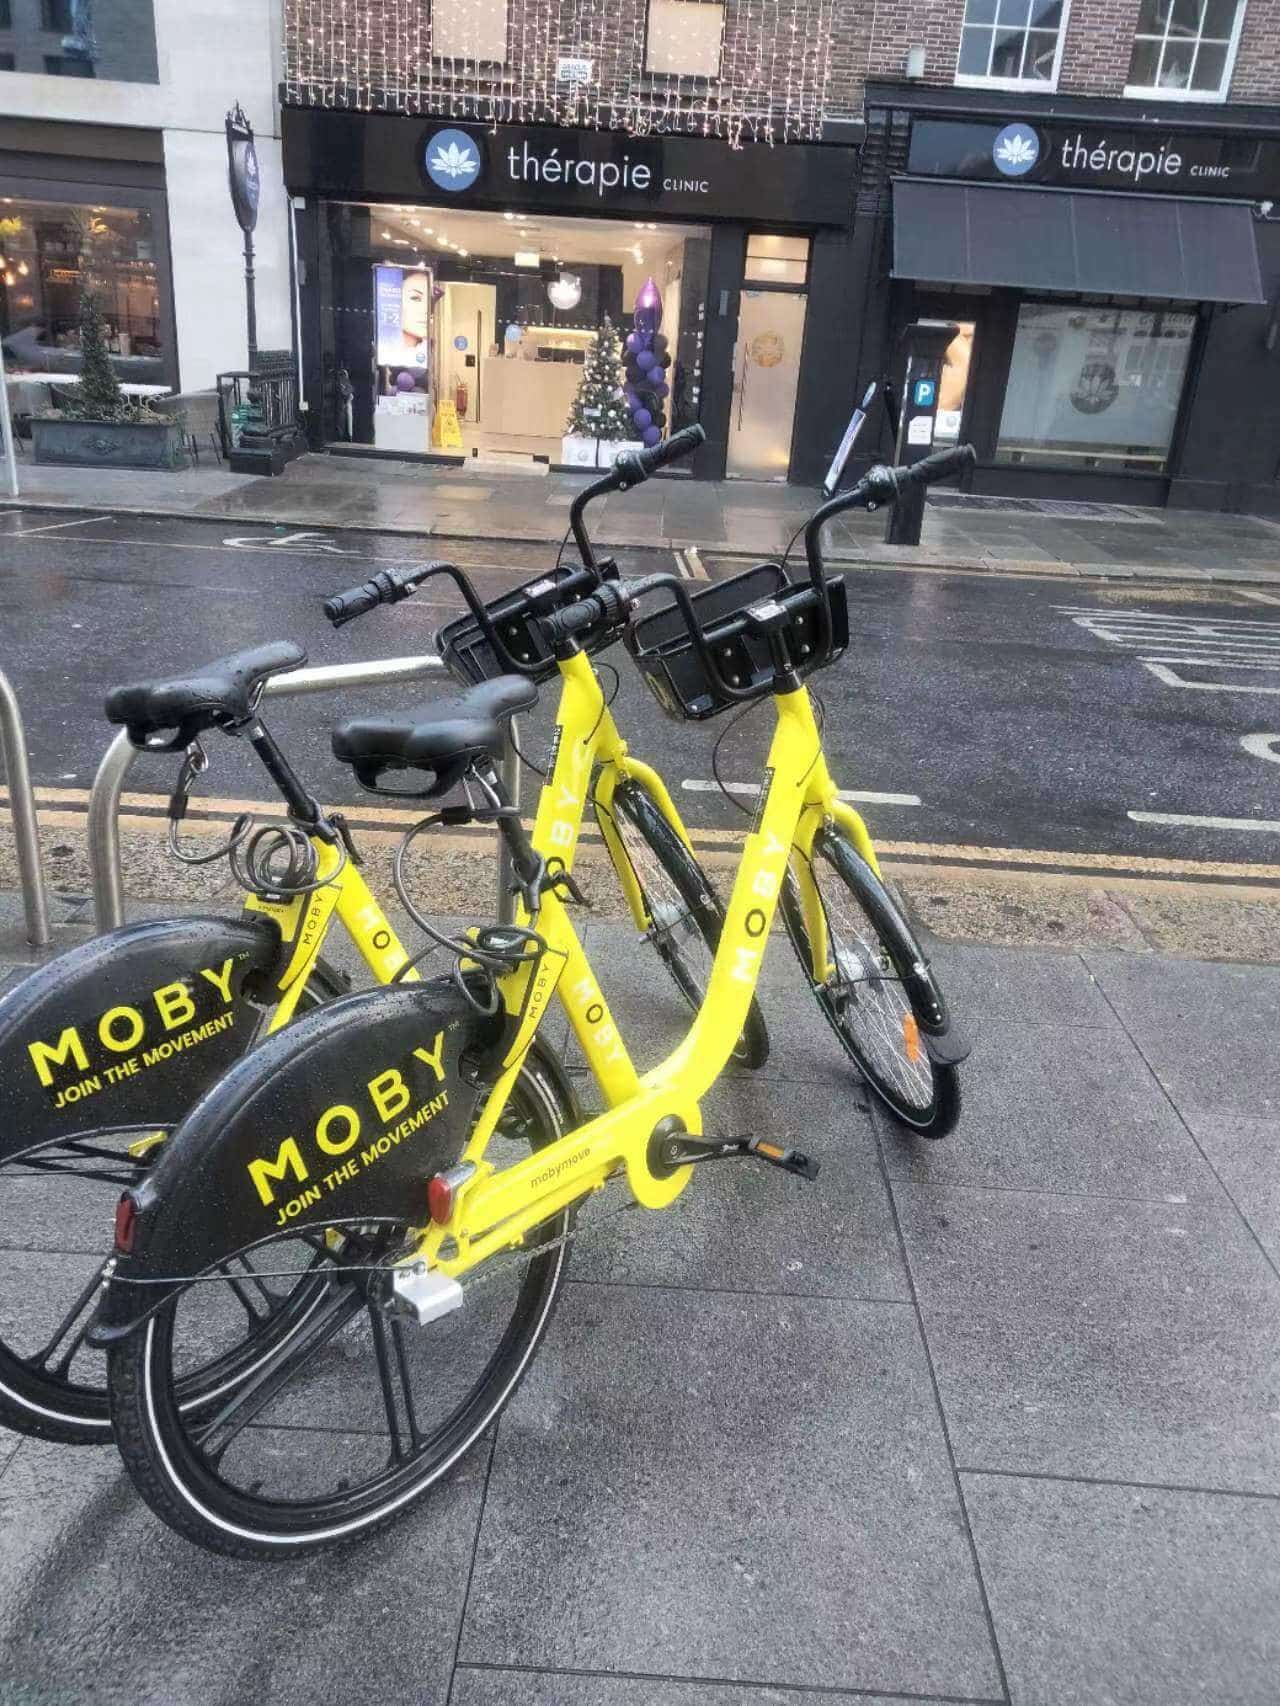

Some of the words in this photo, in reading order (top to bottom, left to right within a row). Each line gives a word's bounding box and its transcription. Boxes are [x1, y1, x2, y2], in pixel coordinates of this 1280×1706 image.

[507, 141, 651, 196] thérapie
[662, 178, 709, 193] CLINIC
[1062, 134, 1182, 181] thérapie
[1190, 165, 1231, 178] CLINIC
[917, 383, 931, 402] P
[303, 893, 325, 945] MOBY
[731, 831, 785, 984] MOBY
[28, 958, 234, 1088] MOBY
[528, 963, 550, 1019] MOBY
[573, 978, 625, 1063] MOBY
[55, 1075, 102, 1109] JOIN
[103, 1058, 141, 1085] THE
[142, 1011, 235, 1067] MOVEMENT
[247, 1030, 445, 1206] MOBY
[276, 1185, 322, 1226] JOIN
[323, 1158, 360, 1191] THE
[360, 1089, 450, 1167] MOVEMENT
[530, 1147, 591, 1189] mobymove
